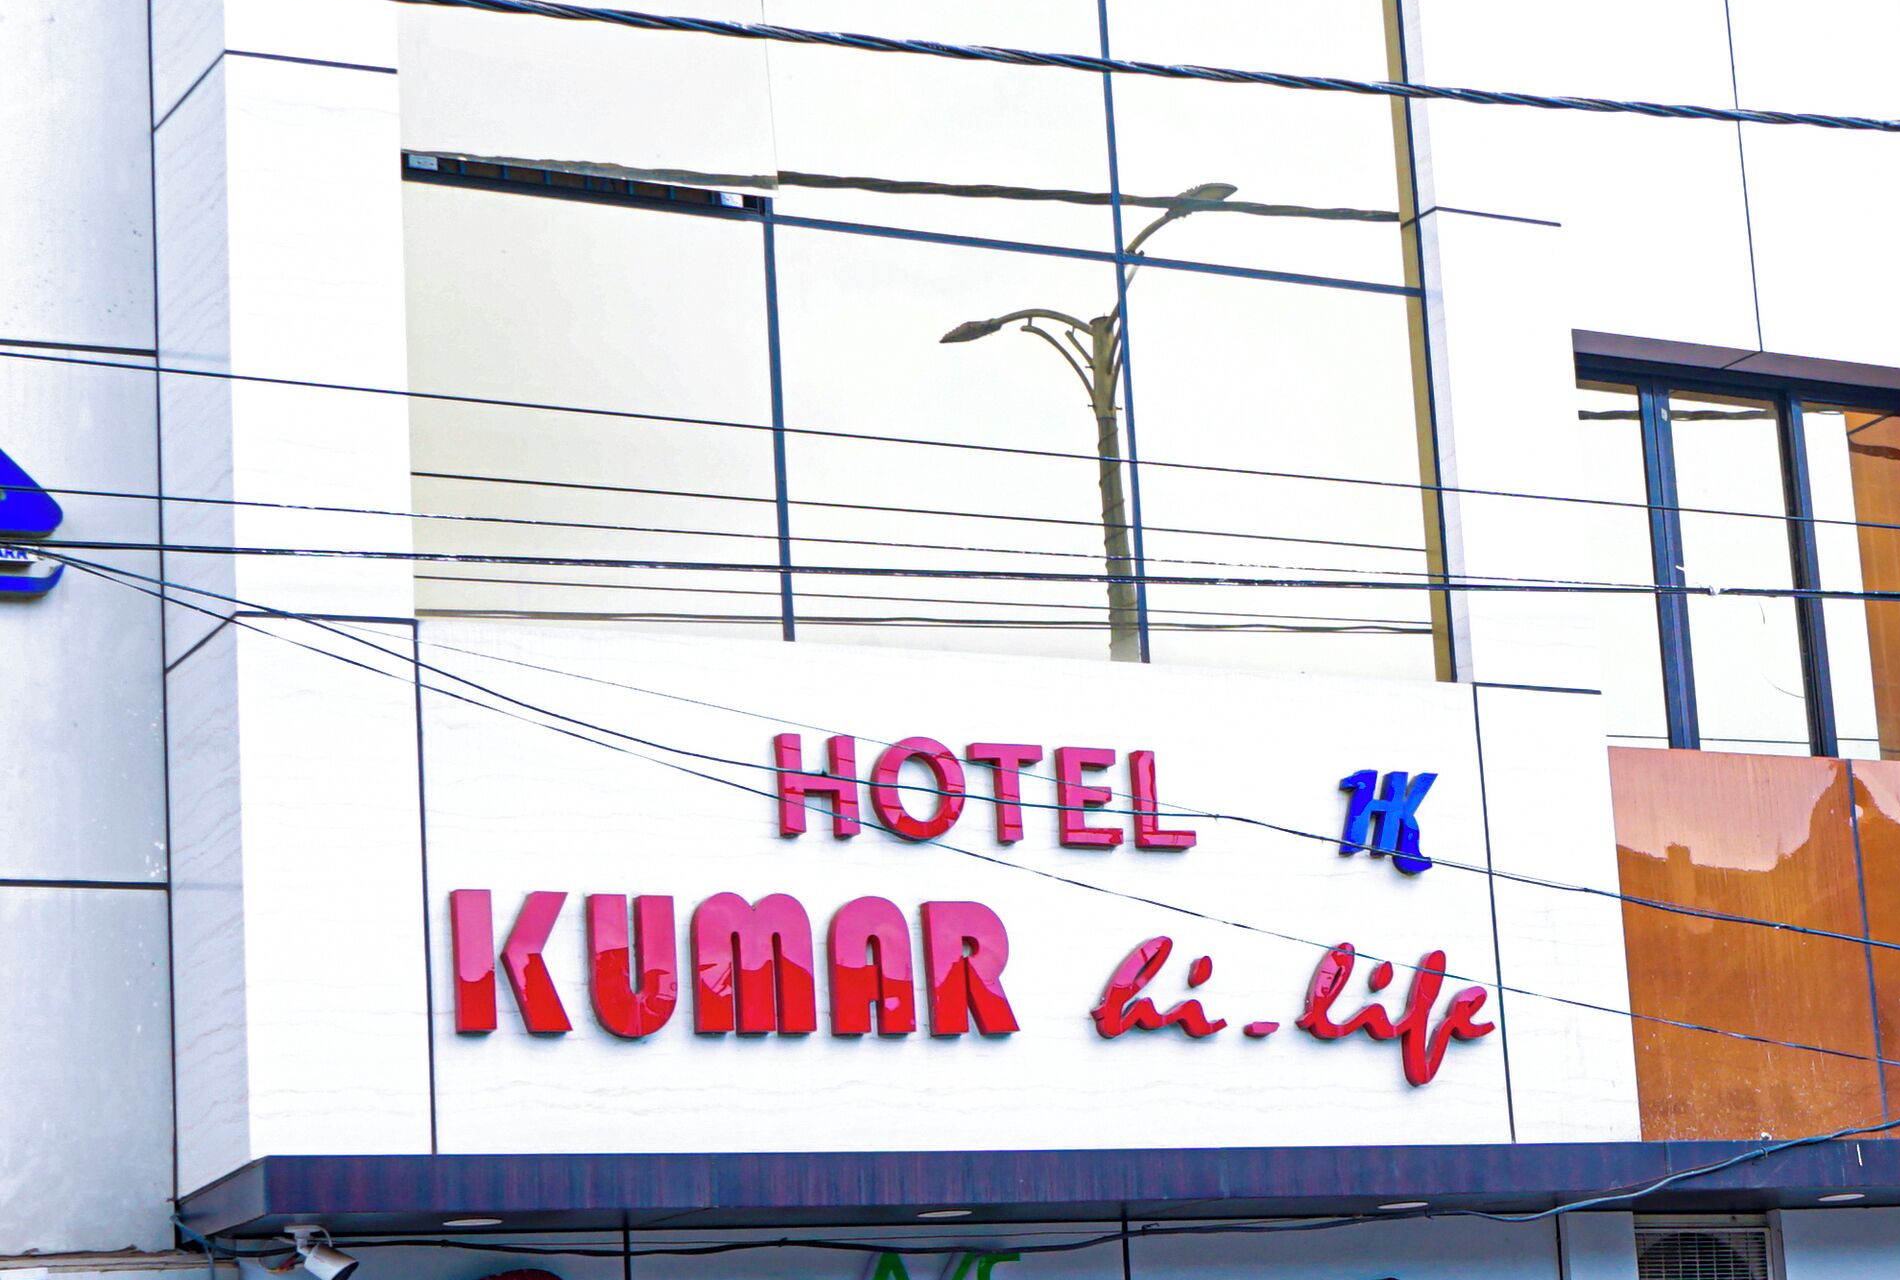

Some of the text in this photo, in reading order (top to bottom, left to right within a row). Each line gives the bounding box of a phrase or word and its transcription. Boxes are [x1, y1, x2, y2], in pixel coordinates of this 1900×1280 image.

[774, 733, 1197, 849] HOTEL
[450, 888, 1020, 1038] KUMAR
[1091, 936, 1496, 1086] hi-life
